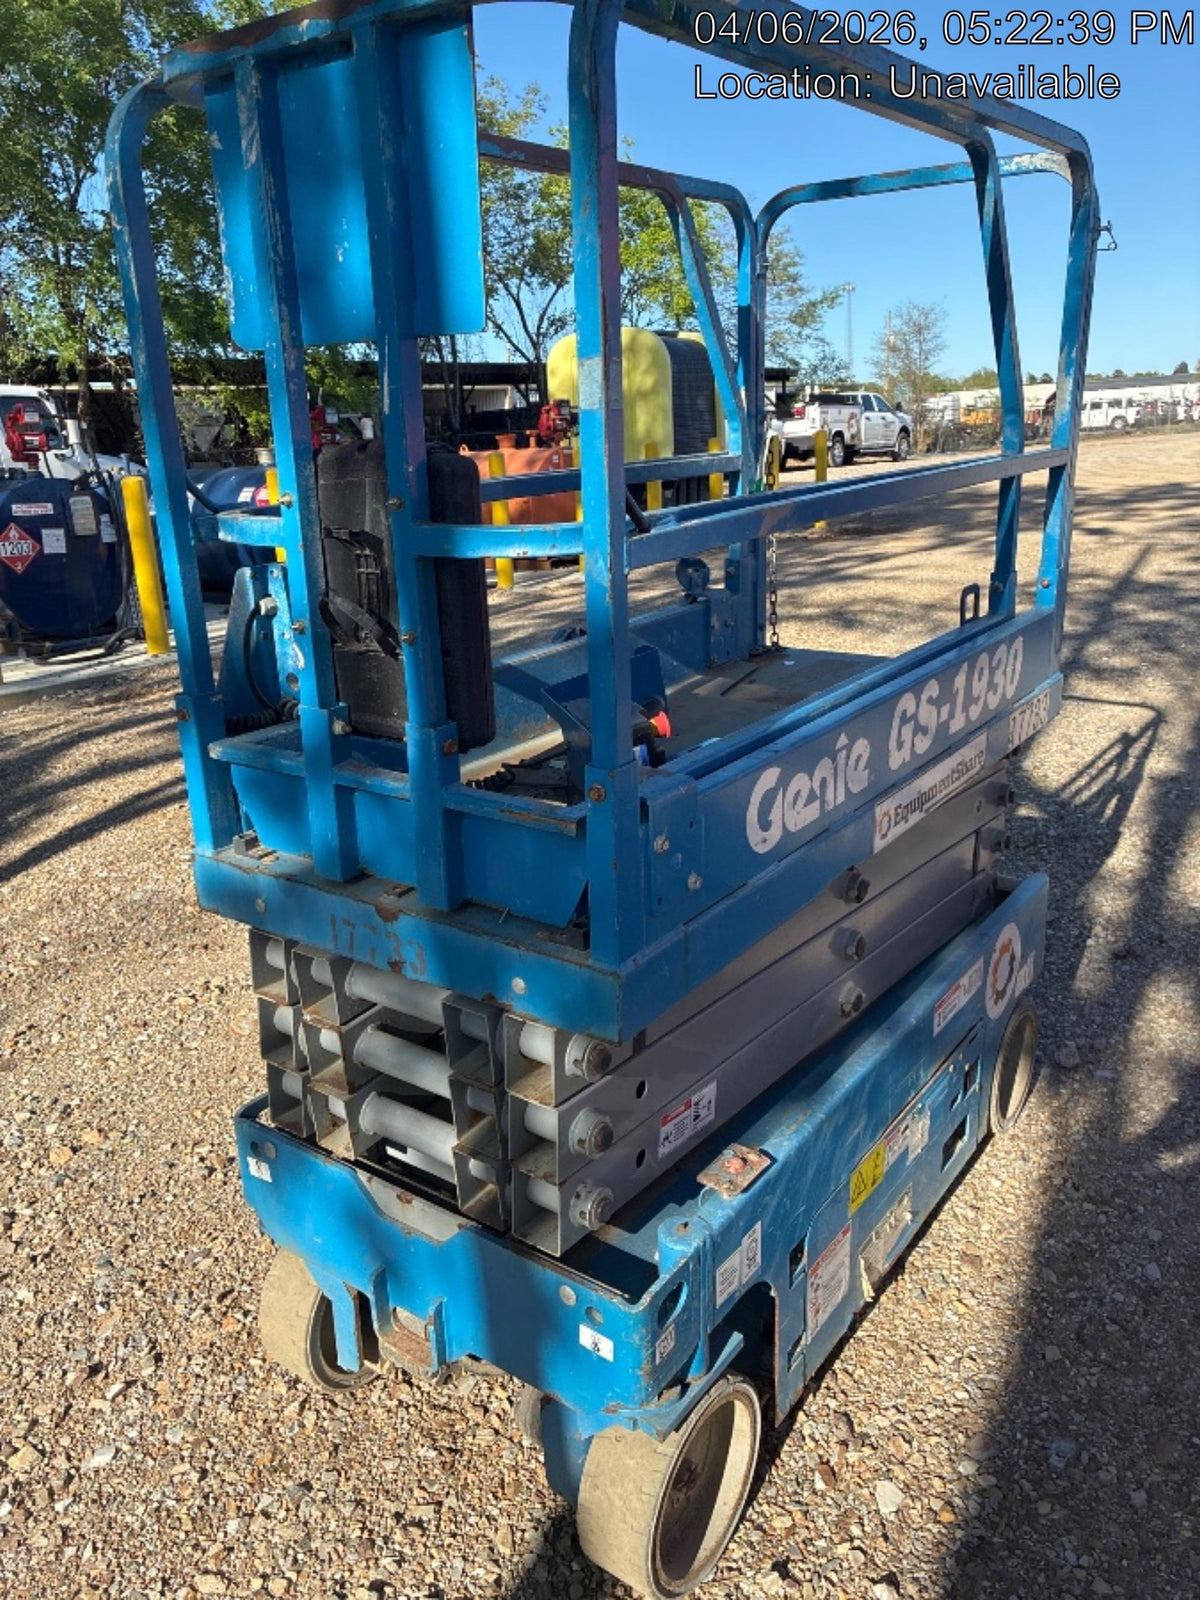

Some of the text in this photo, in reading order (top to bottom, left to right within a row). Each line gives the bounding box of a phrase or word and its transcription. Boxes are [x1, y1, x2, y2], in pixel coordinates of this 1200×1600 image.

[1, 541, 32, 556] 1203
[746, 635, 1024, 854] Genie GS-1930
[893, 749, 985, 828] EquipmentShare
